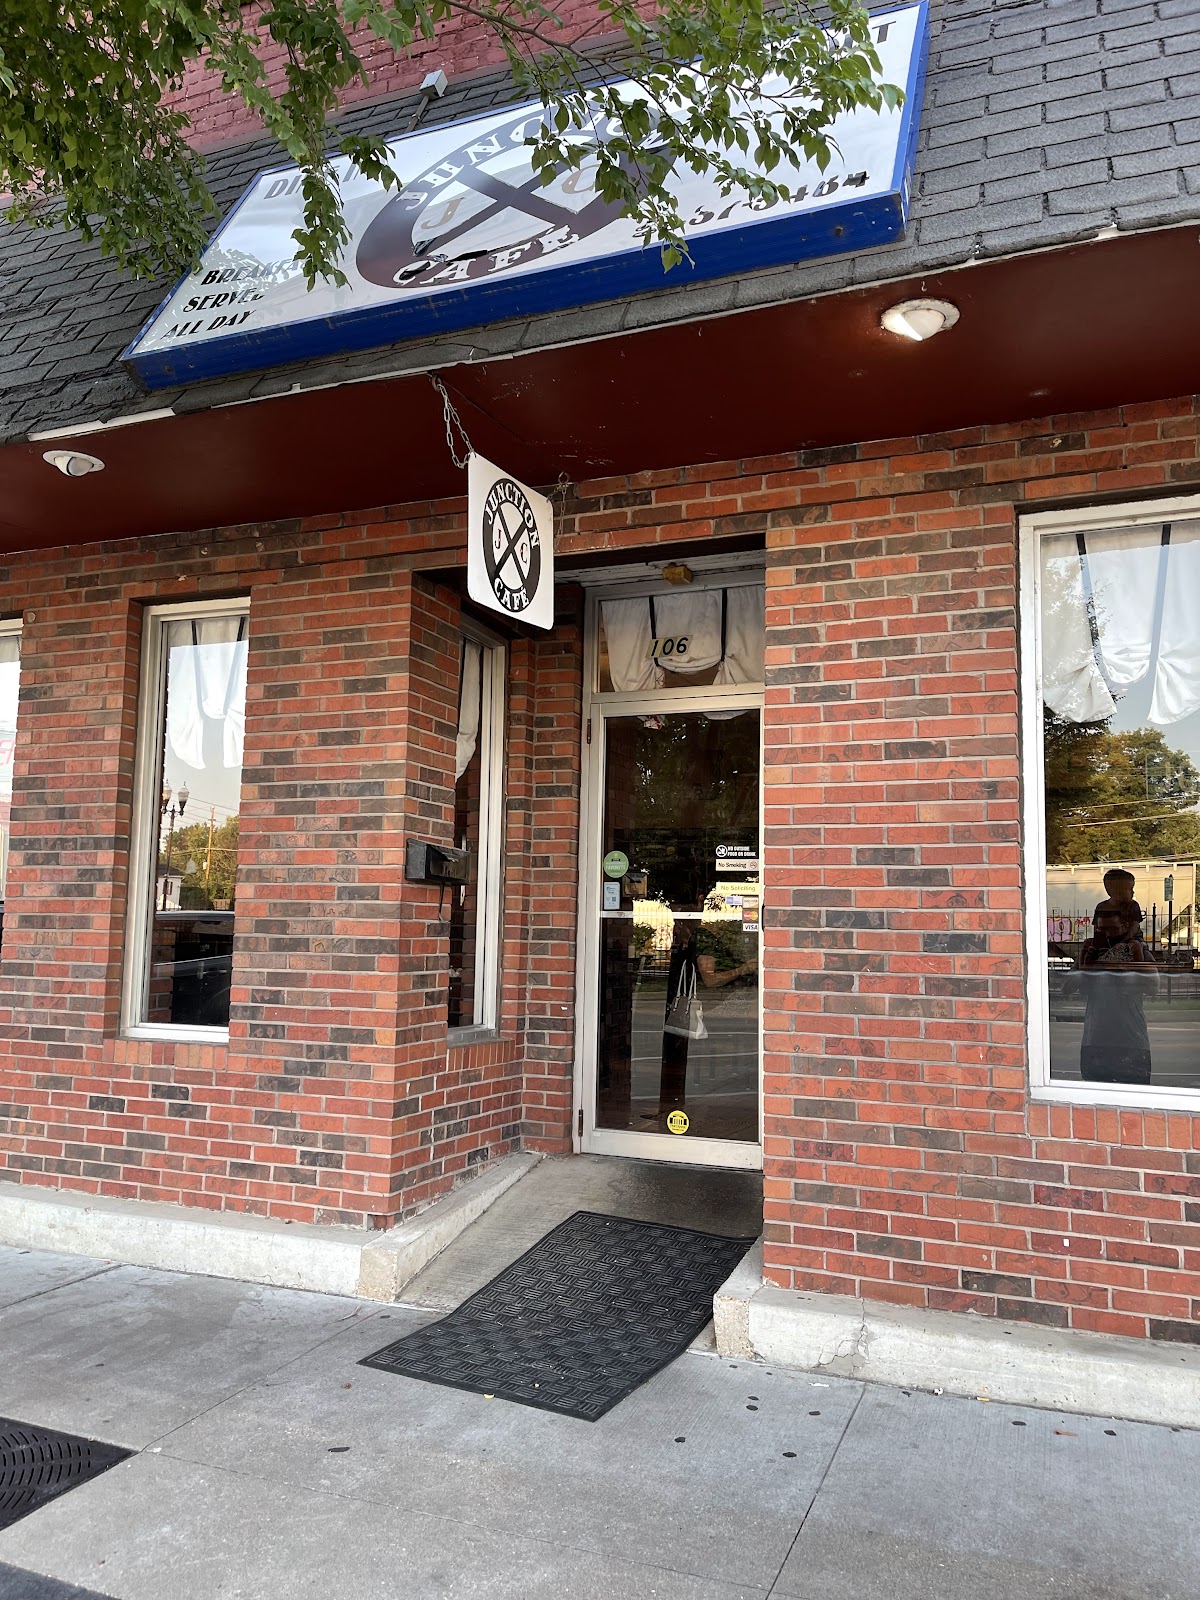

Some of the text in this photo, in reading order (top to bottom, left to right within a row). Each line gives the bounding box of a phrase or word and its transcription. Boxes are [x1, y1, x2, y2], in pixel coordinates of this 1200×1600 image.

[200, 256, 306, 286] BREAKFA
[160, 309, 257, 340] ALL DAY
[484, 482, 540, 549] JUNCTION
[494, 528, 528, 564] J C
[650, 637, 689, 657] 106
